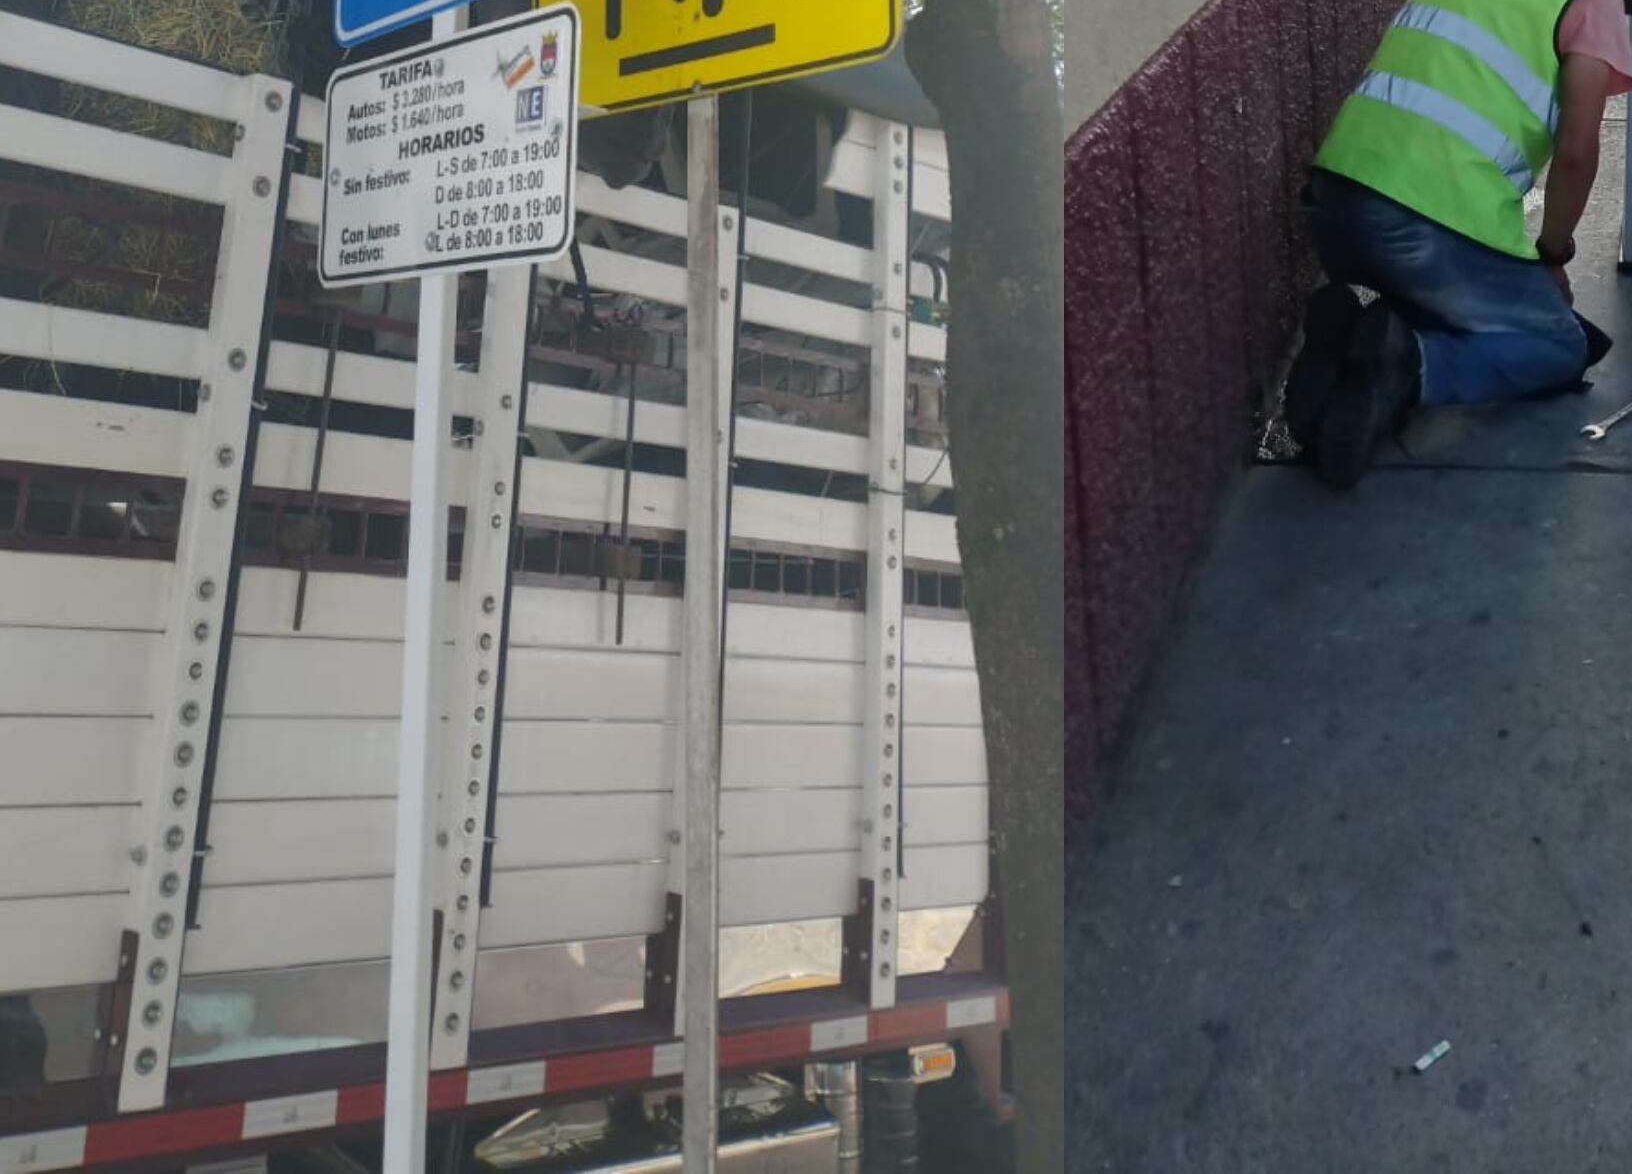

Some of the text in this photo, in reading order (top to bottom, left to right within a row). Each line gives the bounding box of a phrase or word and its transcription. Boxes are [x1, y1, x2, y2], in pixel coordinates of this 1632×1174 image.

[379, 60, 433, 90] TARIFA
[347, 101, 387, 122] Autos:
[346, 123, 387, 145] Motos:
[398, 123, 485, 160] HORARIOS
[436, 137, 560, 178] L-S de 7:00 a 19:00
[343, 168, 411, 196] Sin festivo:
[435, 169, 544, 204] D de 8:00 a 18:00
[437, 194, 562, 231] L-D de 7:00 a 19:00
[341, 222, 401, 246] Con lunes
[447, 231, 462, 250] de
[465, 226, 492, 249] 8:00
[495, 229, 503, 244] a
[508, 221, 544, 245] 18:00
[339, 245, 384, 267] festivo:
